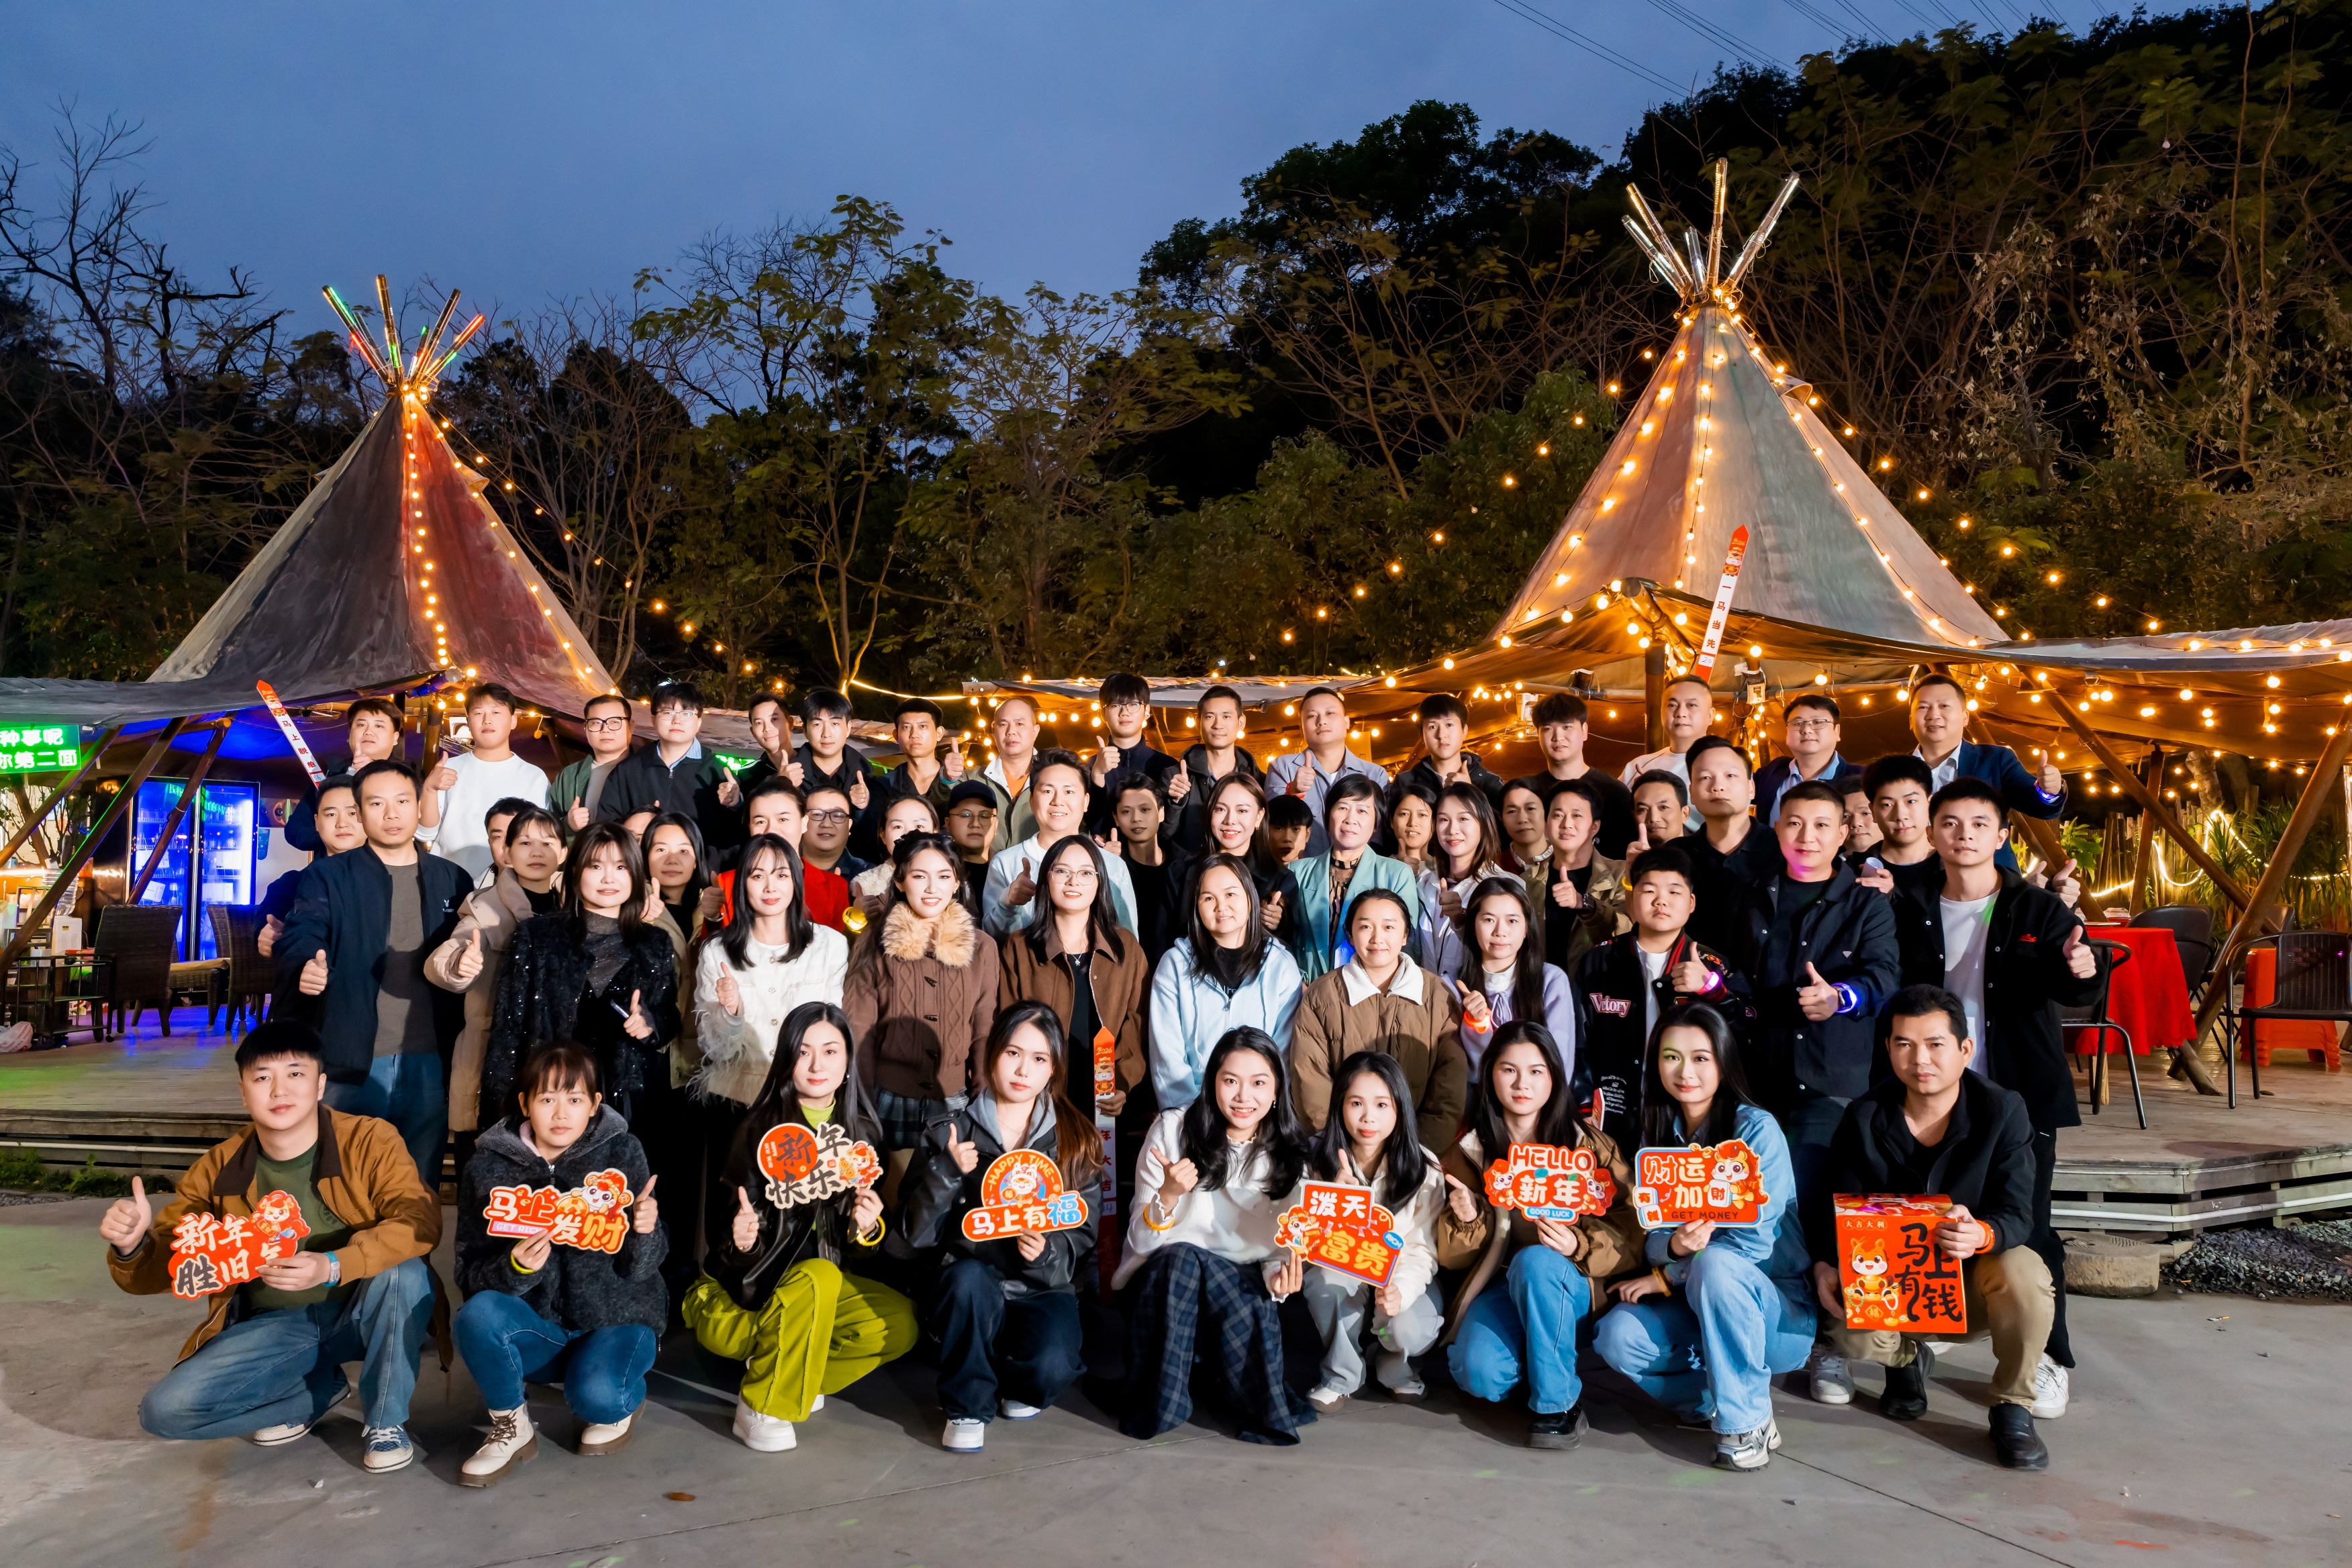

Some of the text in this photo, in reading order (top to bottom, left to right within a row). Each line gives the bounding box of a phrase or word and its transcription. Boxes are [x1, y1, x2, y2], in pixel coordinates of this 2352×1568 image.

[1731, 538, 1746, 546] 2026
[1706, 585, 1732, 648] 一马当先
[282, 720, 316, 769] 马上脱单
[1095, 1046, 1113, 1056] 2026
[777, 1124, 850, 1167] 新年
[1512, 1145, 1594, 1172] HELLO
[769, 1159, 842, 1204] 快乐
[988, 1154, 1055, 1185] HAPPY TIME
[1645, 1155, 1706, 1185] 财运
[1309, 1190, 1367, 1219] 泼天
[1518, 1175, 1581, 1206] 新年
[1674, 1183, 1704, 1208] 加
[485, 1190, 624, 1251] 马上发财
[496, 1222, 516, 1232] GET
[971, 1193, 1081, 1235] 马上有福
[1530, 1208, 1570, 1218] GOOD LUCK
[1671, 1211, 1738, 1220] GET MONEY
[1845, 1218, 1885, 1229] 大吉大利
[173, 1214, 254, 1255] 新年
[1320, 1230, 1389, 1277] 富贵
[1897, 1223, 1958, 1279] 马上
[1894, 1264, 1963, 1322] 有钱
